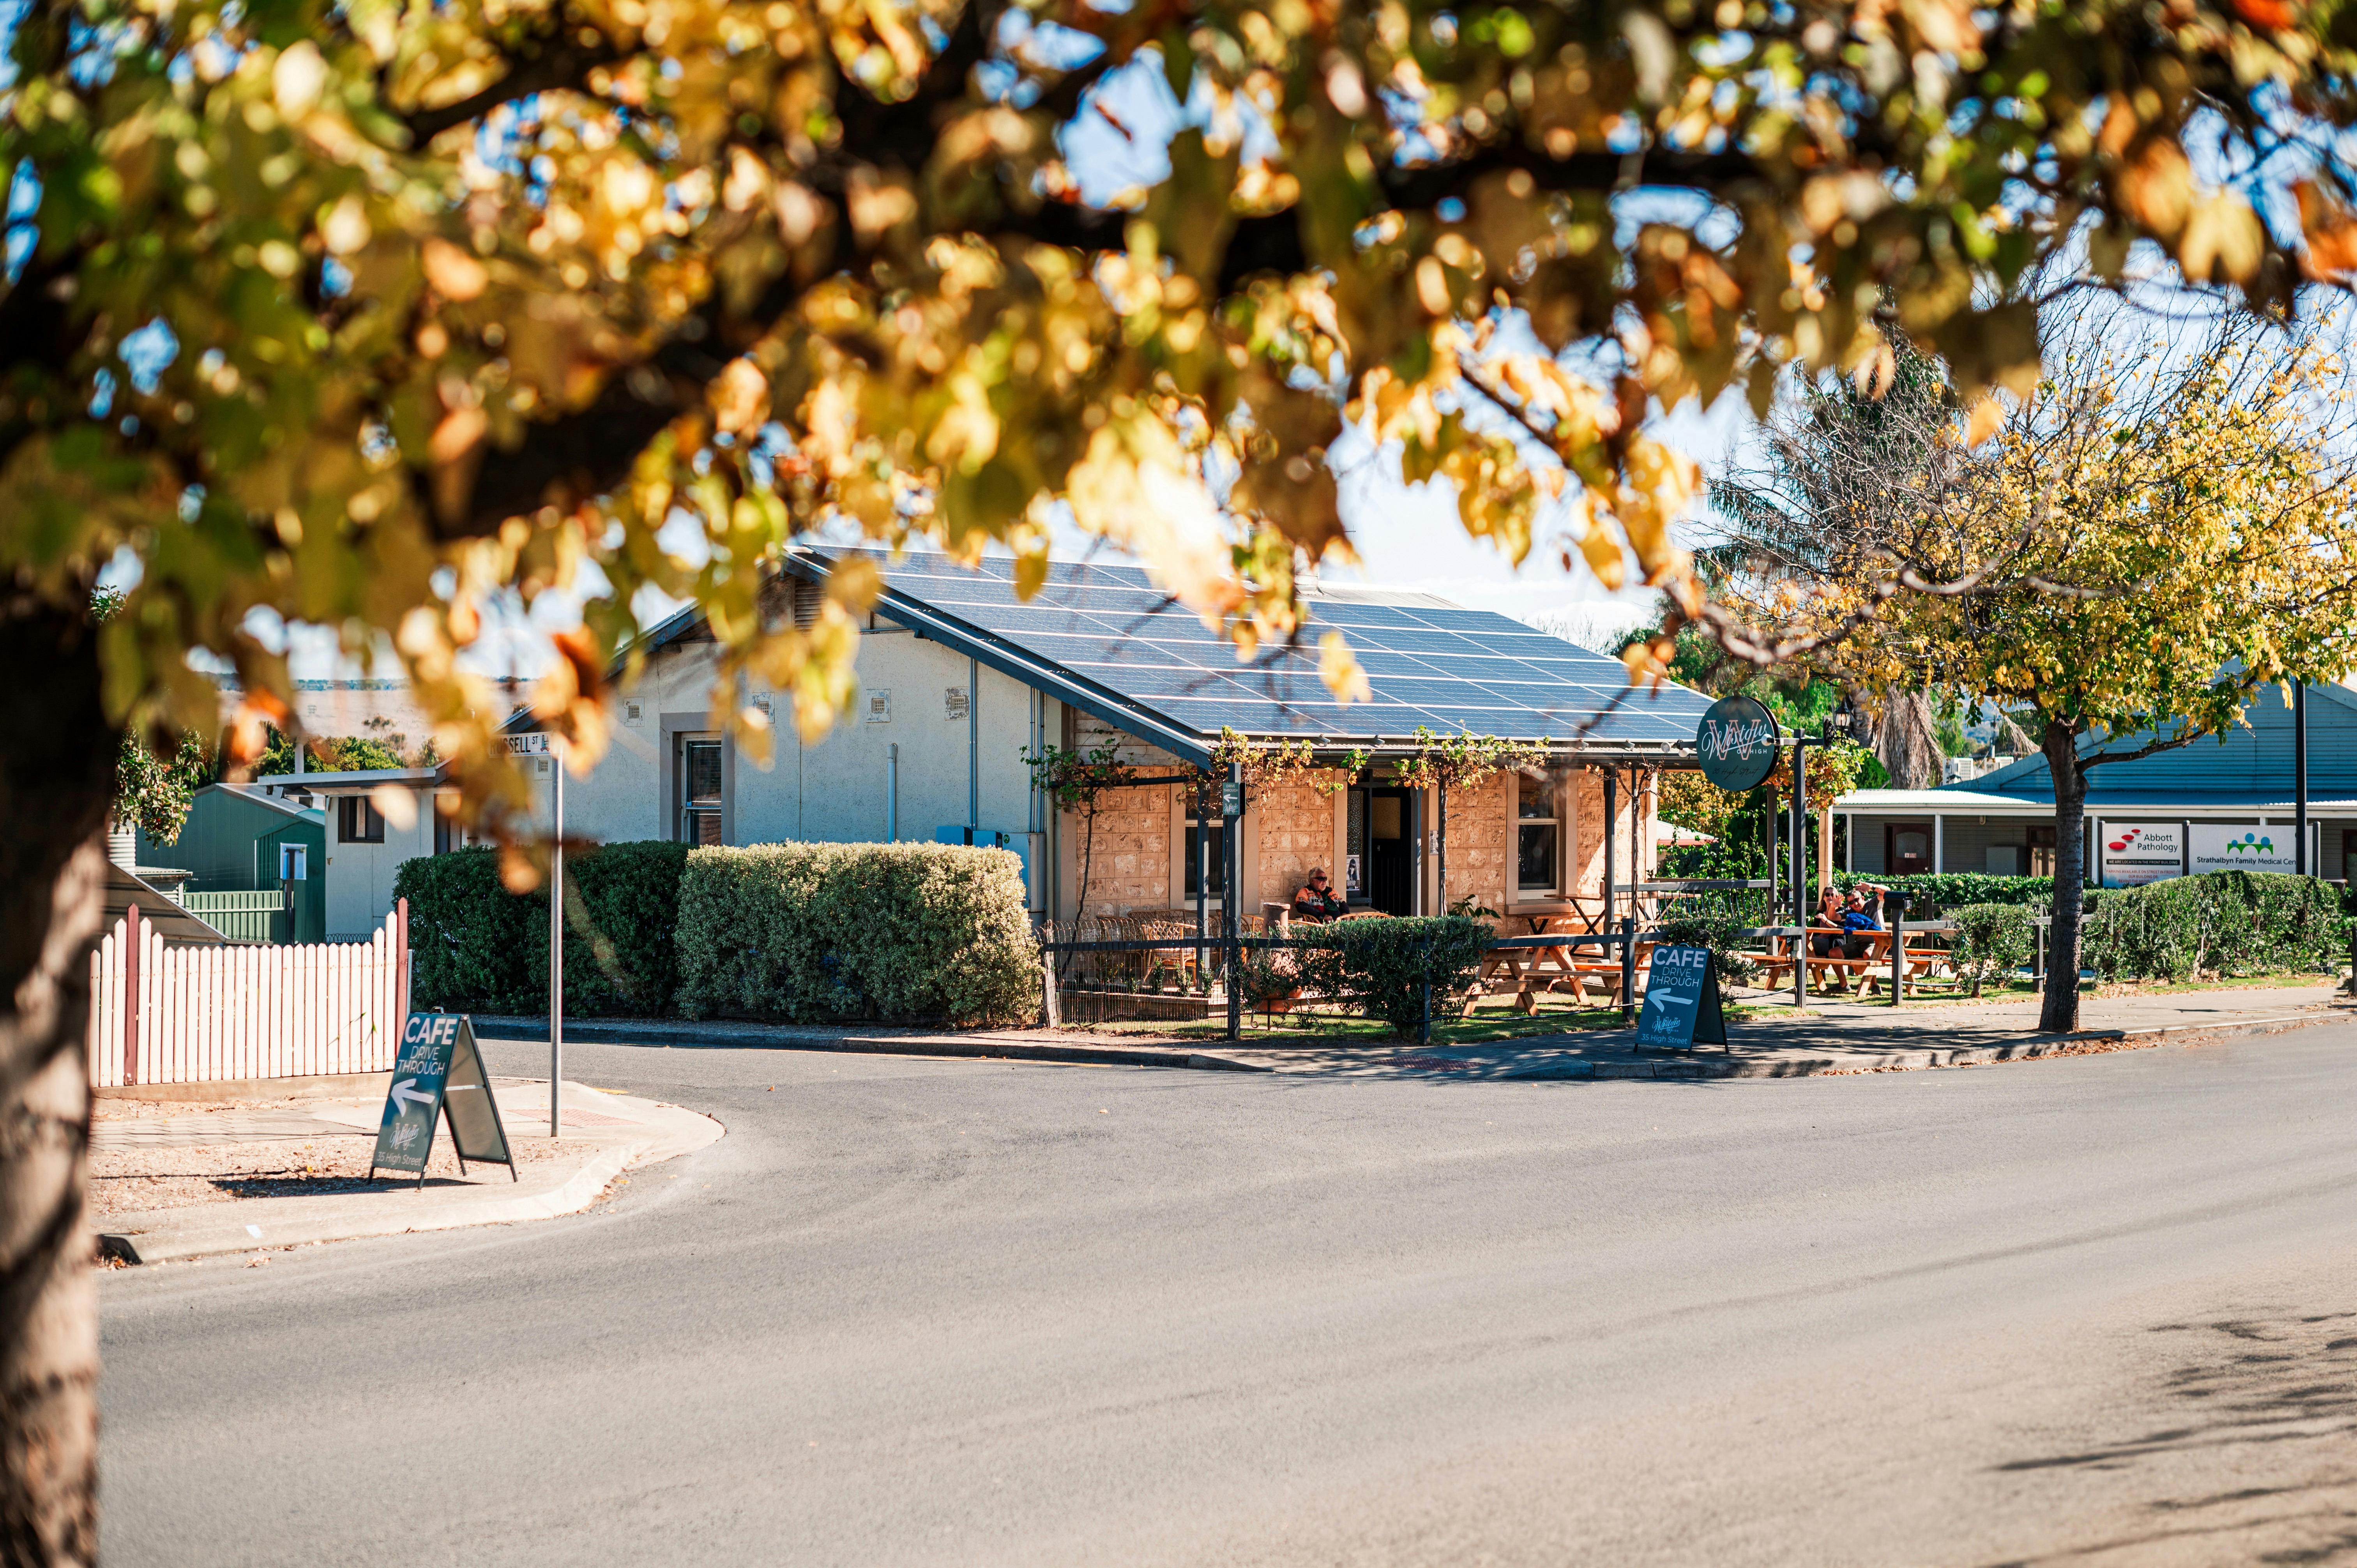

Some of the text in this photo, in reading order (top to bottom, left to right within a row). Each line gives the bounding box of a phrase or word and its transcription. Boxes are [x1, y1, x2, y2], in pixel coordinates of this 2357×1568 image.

[532, 736, 538, 744] ST
[1701, 724, 1768, 760] Wistow
[2138, 843, 2178, 853] Pathology
[2197, 856, 2234, 865] Strathalbyn
[1654, 948, 1706, 968] CAFE
[1663, 967, 1692, 977] DRIVE
[1651, 975, 1700, 987] THROUGH
[405, 1017, 458, 1045] CAFE
[1650, 1035, 1666, 1043] High
[1668, 1036, 1687, 1044] Street
[410, 1046, 440, 1060] DRIVE
[398, 1059, 445, 1075] THROUGH
[376, 1151, 422, 1166] 35 High Street
